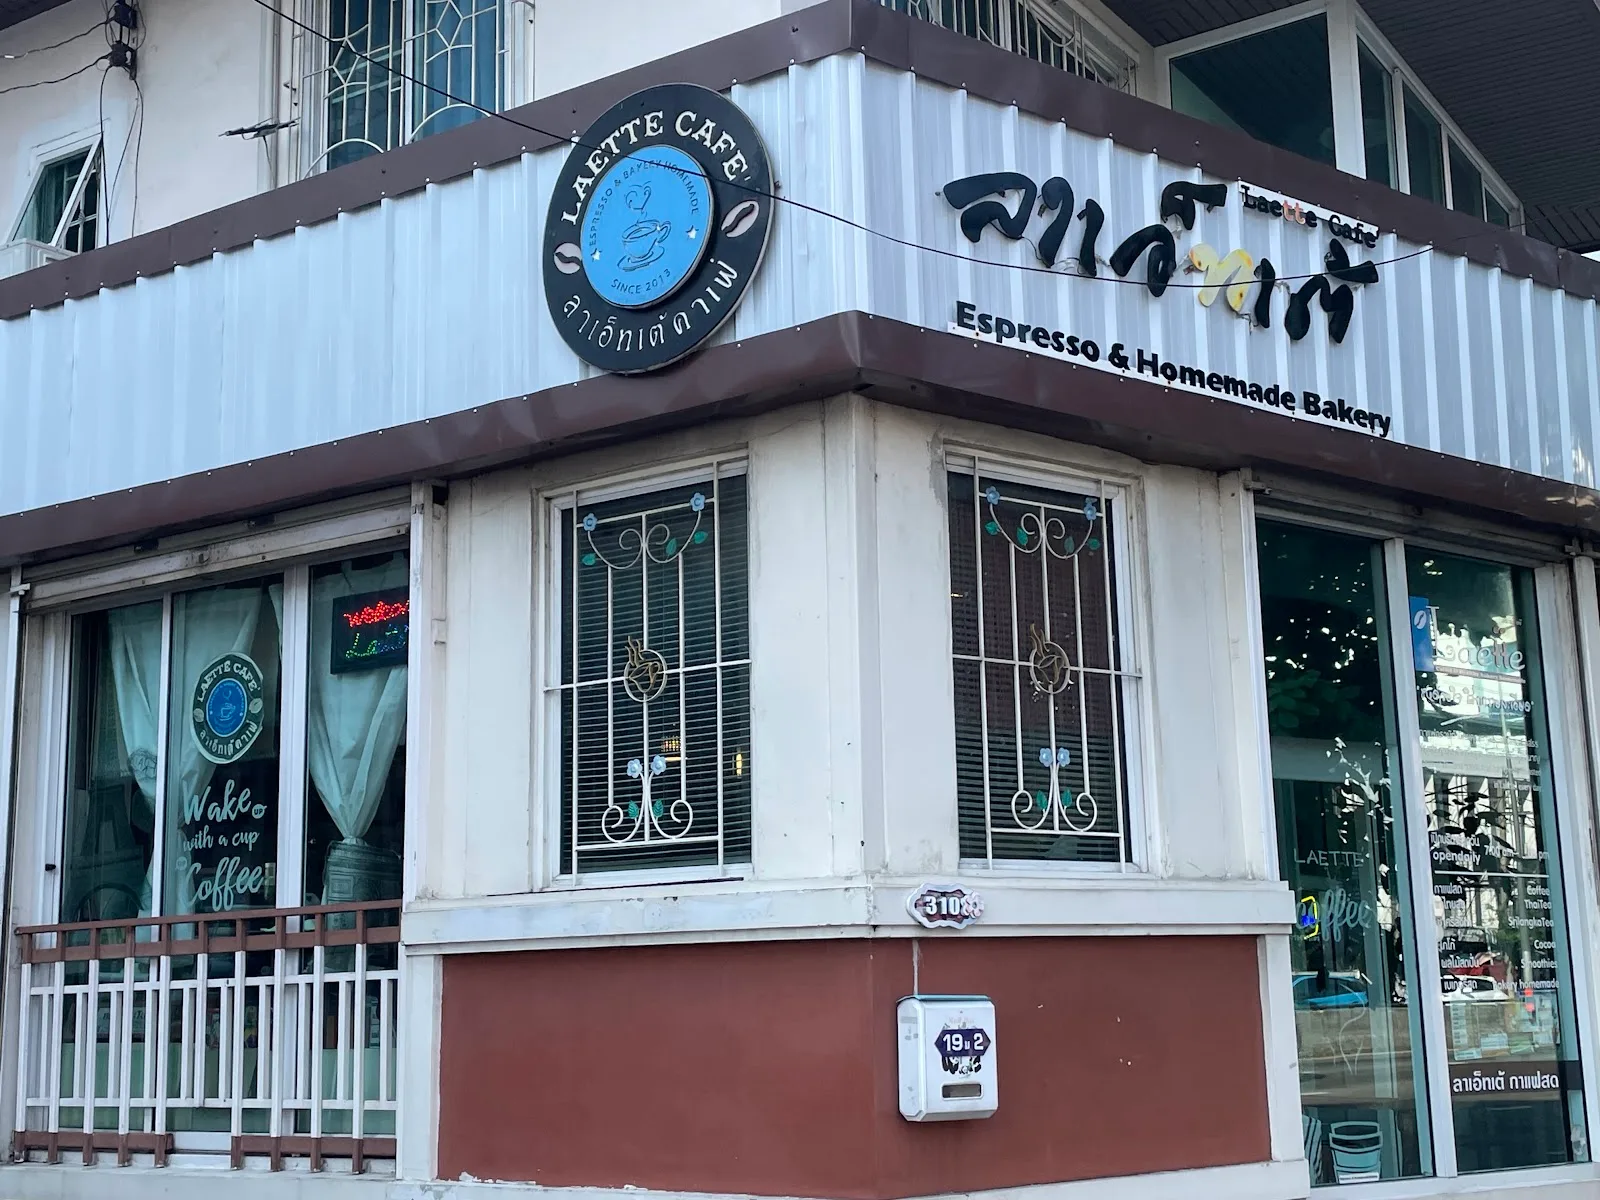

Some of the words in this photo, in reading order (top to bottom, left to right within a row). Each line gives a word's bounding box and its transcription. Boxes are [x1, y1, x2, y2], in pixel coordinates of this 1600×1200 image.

[561, 110, 664, 225] LAETTE
[588, 188, 614, 247] ESPRESSO
[1240, 184, 1318, 228] Laette
[611, 278, 642, 295] SINCE
[645, 267, 672, 292] 2013
[956, 300, 1101, 363] Espresso
[1108, 342, 1131, 371] &
[1136, 347, 1297, 412] Homemade
[1302, 390, 1391, 438] Bakery
[197, 660, 232, 702] LAETTE
[182, 778, 252, 826] Wake
[183, 824, 214, 851] with
[218, 834, 229, 847] a
[232, 831, 260, 852] cup
[1293, 848, 1364, 868] LAETTE
[181, 856, 265, 912] Coffee
[1526, 885, 1551, 896] Coffee
[1533, 939, 1556, 949] Cocoa
[942, 1032, 964, 1052] 19
[973, 1032, 985, 1051] 2
[1452, 1070, 1506, 1093] ลาเอ็ทเต้
[1509, 1070, 1560, 1090] กาแฟสด
